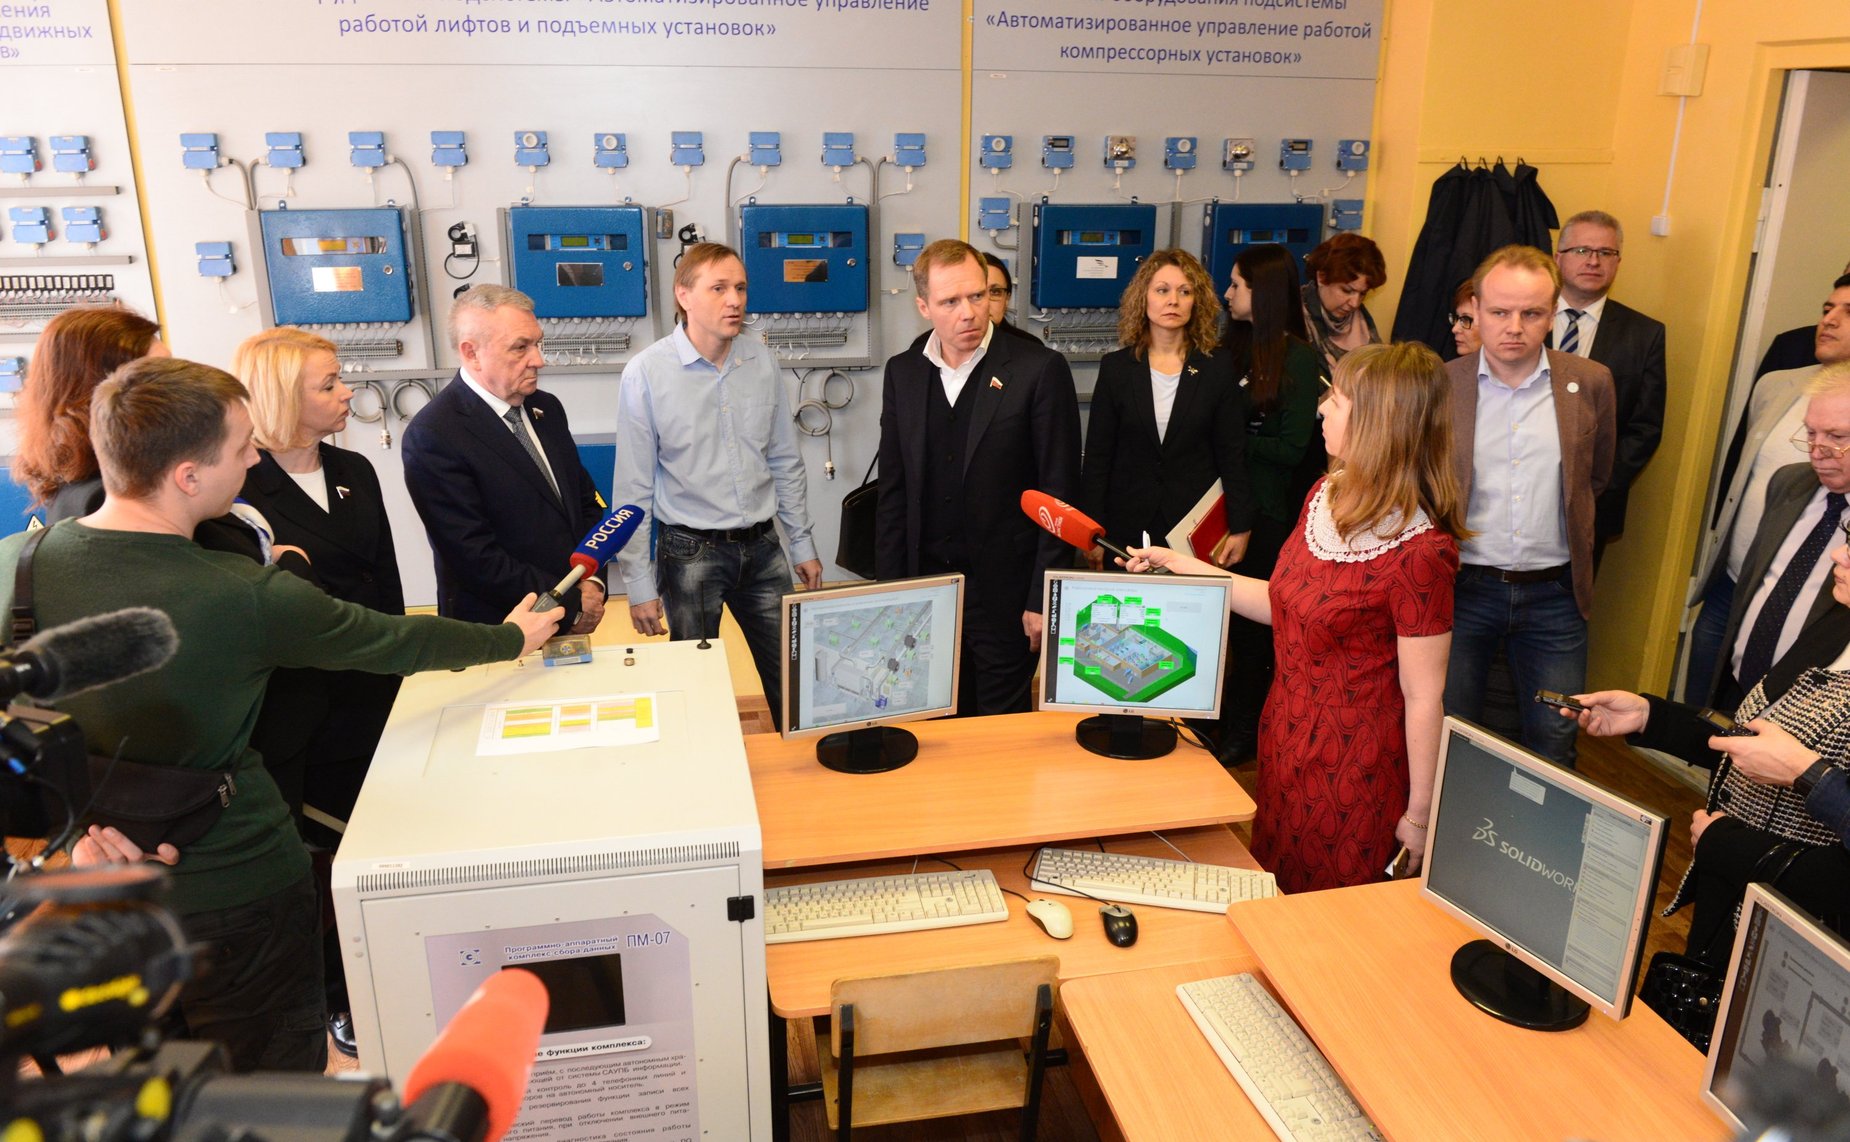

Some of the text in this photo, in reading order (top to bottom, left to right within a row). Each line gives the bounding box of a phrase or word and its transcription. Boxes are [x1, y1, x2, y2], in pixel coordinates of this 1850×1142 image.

[0, 5, 51, 18] ения
[339, 14, 776, 38] работой лифтов и подъемных установок»
[986, 11, 1372, 40] «Автоматизированное управление работой
[1060, 44, 1302, 65] компрессорных установок»
[585, 509, 634, 550] РОССИЯ
[627, 931, 671, 948] ПМ-07
[508, 945, 616, 961] комплекс сбора данных
[546, 1046, 589, 1057] функции
[591, 1039, 646, 1050] комплекса:
